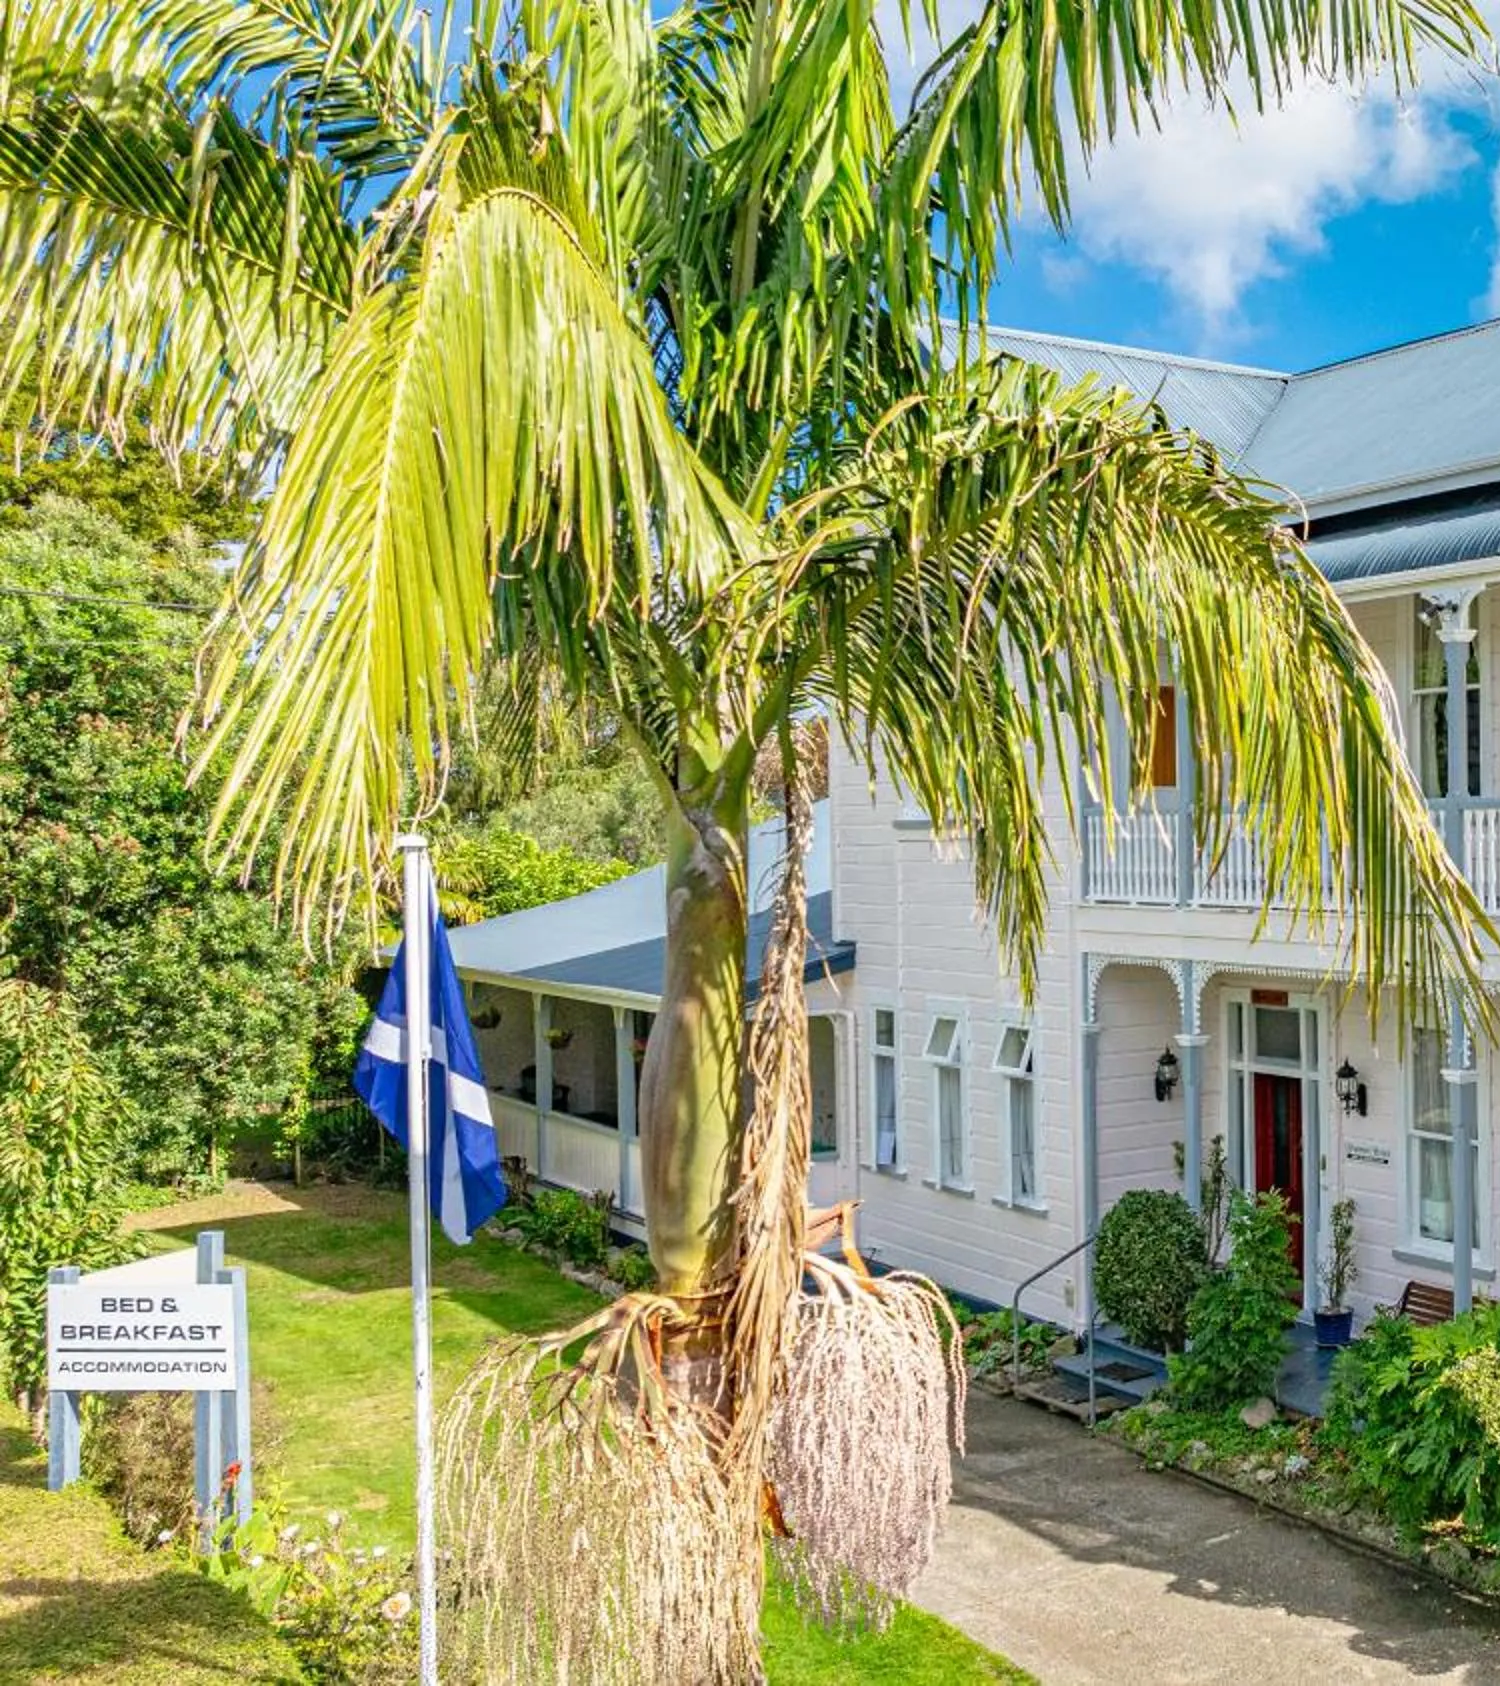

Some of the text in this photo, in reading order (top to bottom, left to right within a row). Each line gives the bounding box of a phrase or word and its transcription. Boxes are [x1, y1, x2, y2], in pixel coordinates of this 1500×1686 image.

[101, 1297, 180, 1313] BED &
[60, 1325, 222, 1340] BREAKFAST
[58, 1361, 227, 1373] ACCOMMODATION
